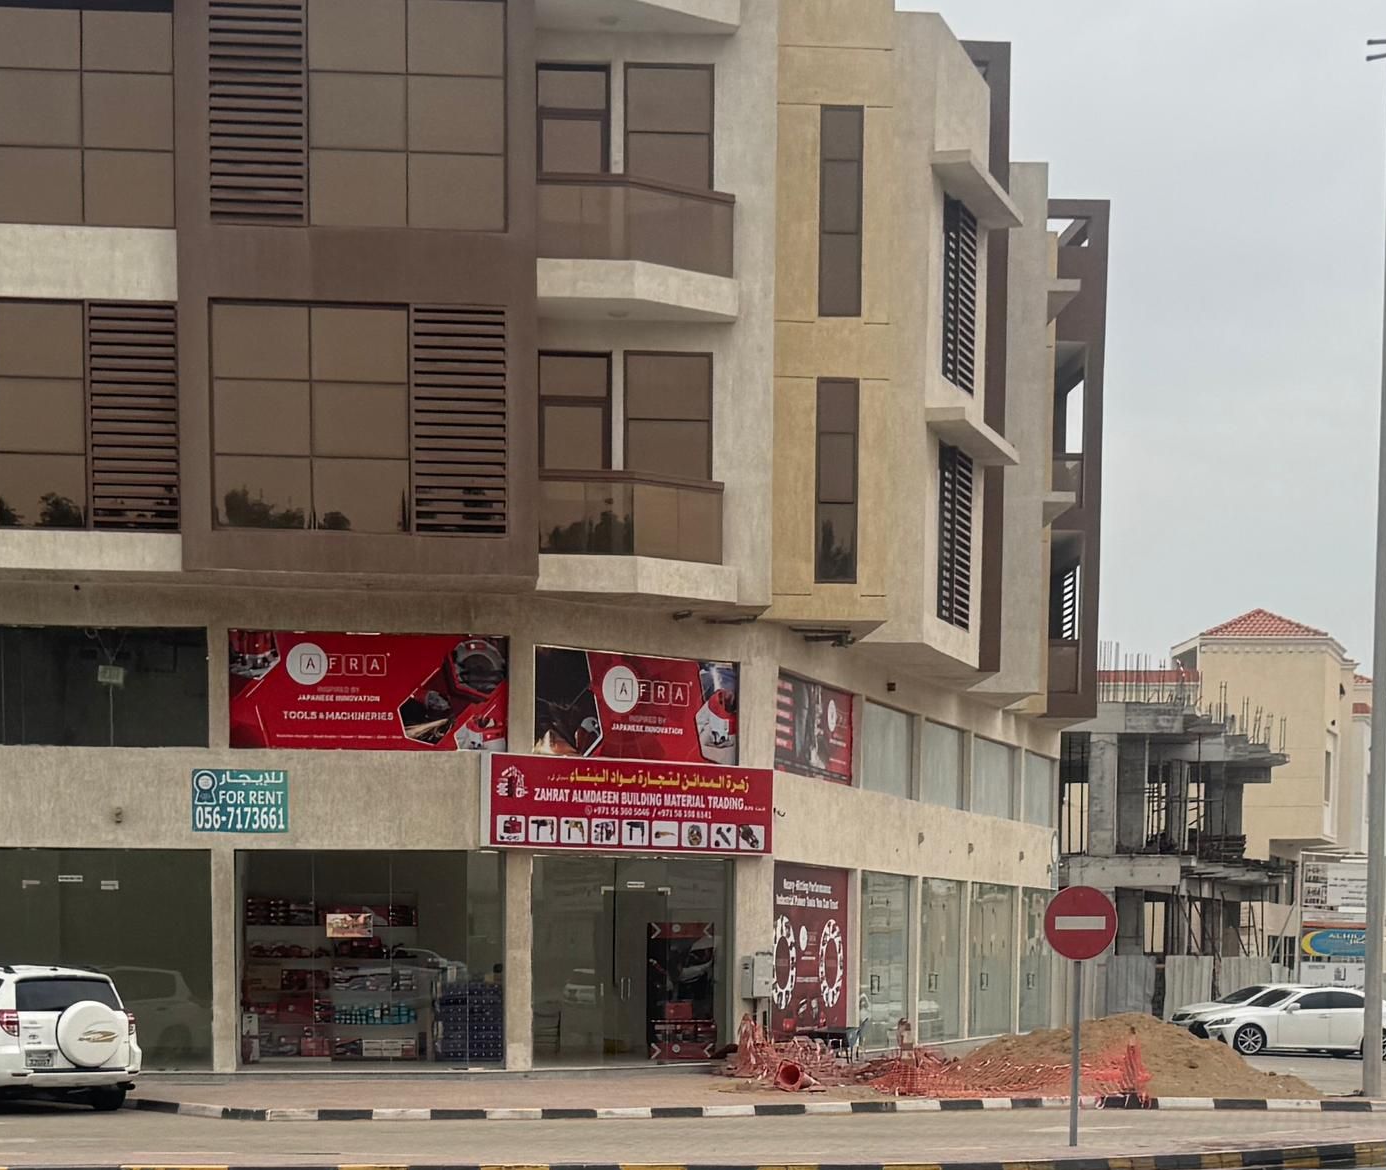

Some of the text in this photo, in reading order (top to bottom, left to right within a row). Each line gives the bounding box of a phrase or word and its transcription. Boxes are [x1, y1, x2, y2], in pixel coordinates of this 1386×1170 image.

[305, 656, 380, 671] AFRA
[619, 681, 684, 702] AFRA
[283, 711, 317, 720] TOOLS
[325, 711, 393, 721] MACHINERIES
[219, 790, 284, 805] FOR RENT
[534, 787, 570, 802] ZAHRAT
[572, 789, 619, 805] ALMDAEEN
[621, 791, 662, 807] BUILDING
[664, 793, 706, 808] MATERIAL
[707, 796, 744, 811] TRADING
[195, 806, 285, 830] 056-7173661
